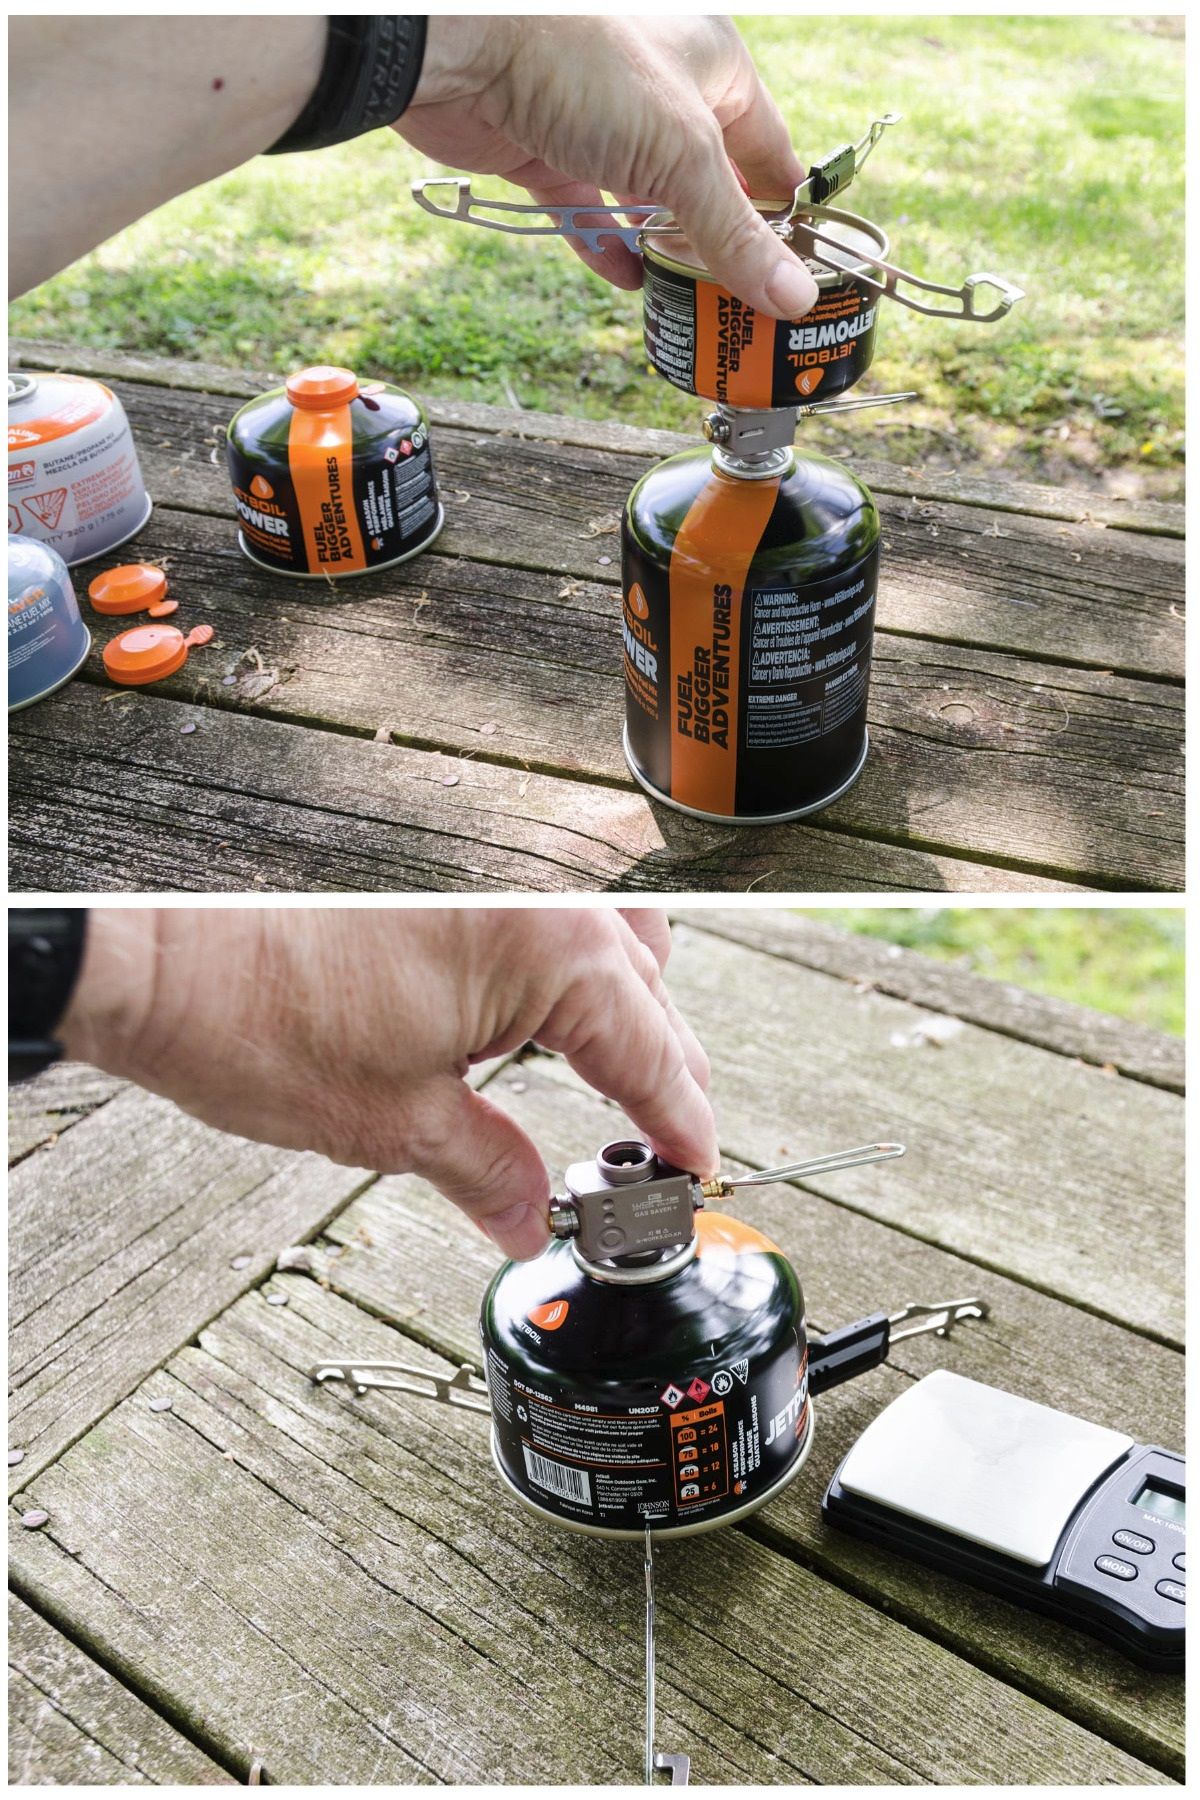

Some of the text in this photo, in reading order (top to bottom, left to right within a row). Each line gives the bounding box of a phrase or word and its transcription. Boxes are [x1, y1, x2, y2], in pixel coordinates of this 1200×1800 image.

[728, 296, 743, 373] BIGGER
[741, 305, 755, 350] UEL
[716, 295, 730, 404] ADVENTUR
[787, 340, 857, 367] JETBOIL
[326, 456, 354, 559] ADVENTURES
[321, 502, 342, 562] BIGGER
[313, 521, 329, 563] FUEL
[763, 592, 799, 605] WARNING:
[754, 606, 771, 618] Cancer
[771, 606, 781, 617] and
[781, 604, 809, 619] Reproductive
[762, 615, 820, 635] AVERTISSEMENT:
[769, 637, 775, 647] et
[760, 648, 811, 665] ADVERTENCIA:
[711, 583, 732, 750] ADVENTURES
[677, 671, 693, 738] FUEL
[693, 646, 711, 744] BIGGER
[748, 692, 798, 704] EXTREME DANGER
[513, 1379, 526, 1391] DOT
[628, 1406, 660, 1415] UN2037
[680, 1424, 718, 1441] 100 24
[683, 1442, 719, 1459] 75 18
[737, 1419, 747, 1476] PERFORMANCE
[752, 1431, 760, 1468] QUATRE
[684, 1461, 720, 1477] 50 12
[686, 1481, 717, 1497] 25 6
[637, 1500, 670, 1513] JOHNSON
[1116, 1532, 1152, 1552] ON/OFF
[1102, 1559, 1133, 1577] MODE
[1164, 1585, 1186, 1598] PCS
